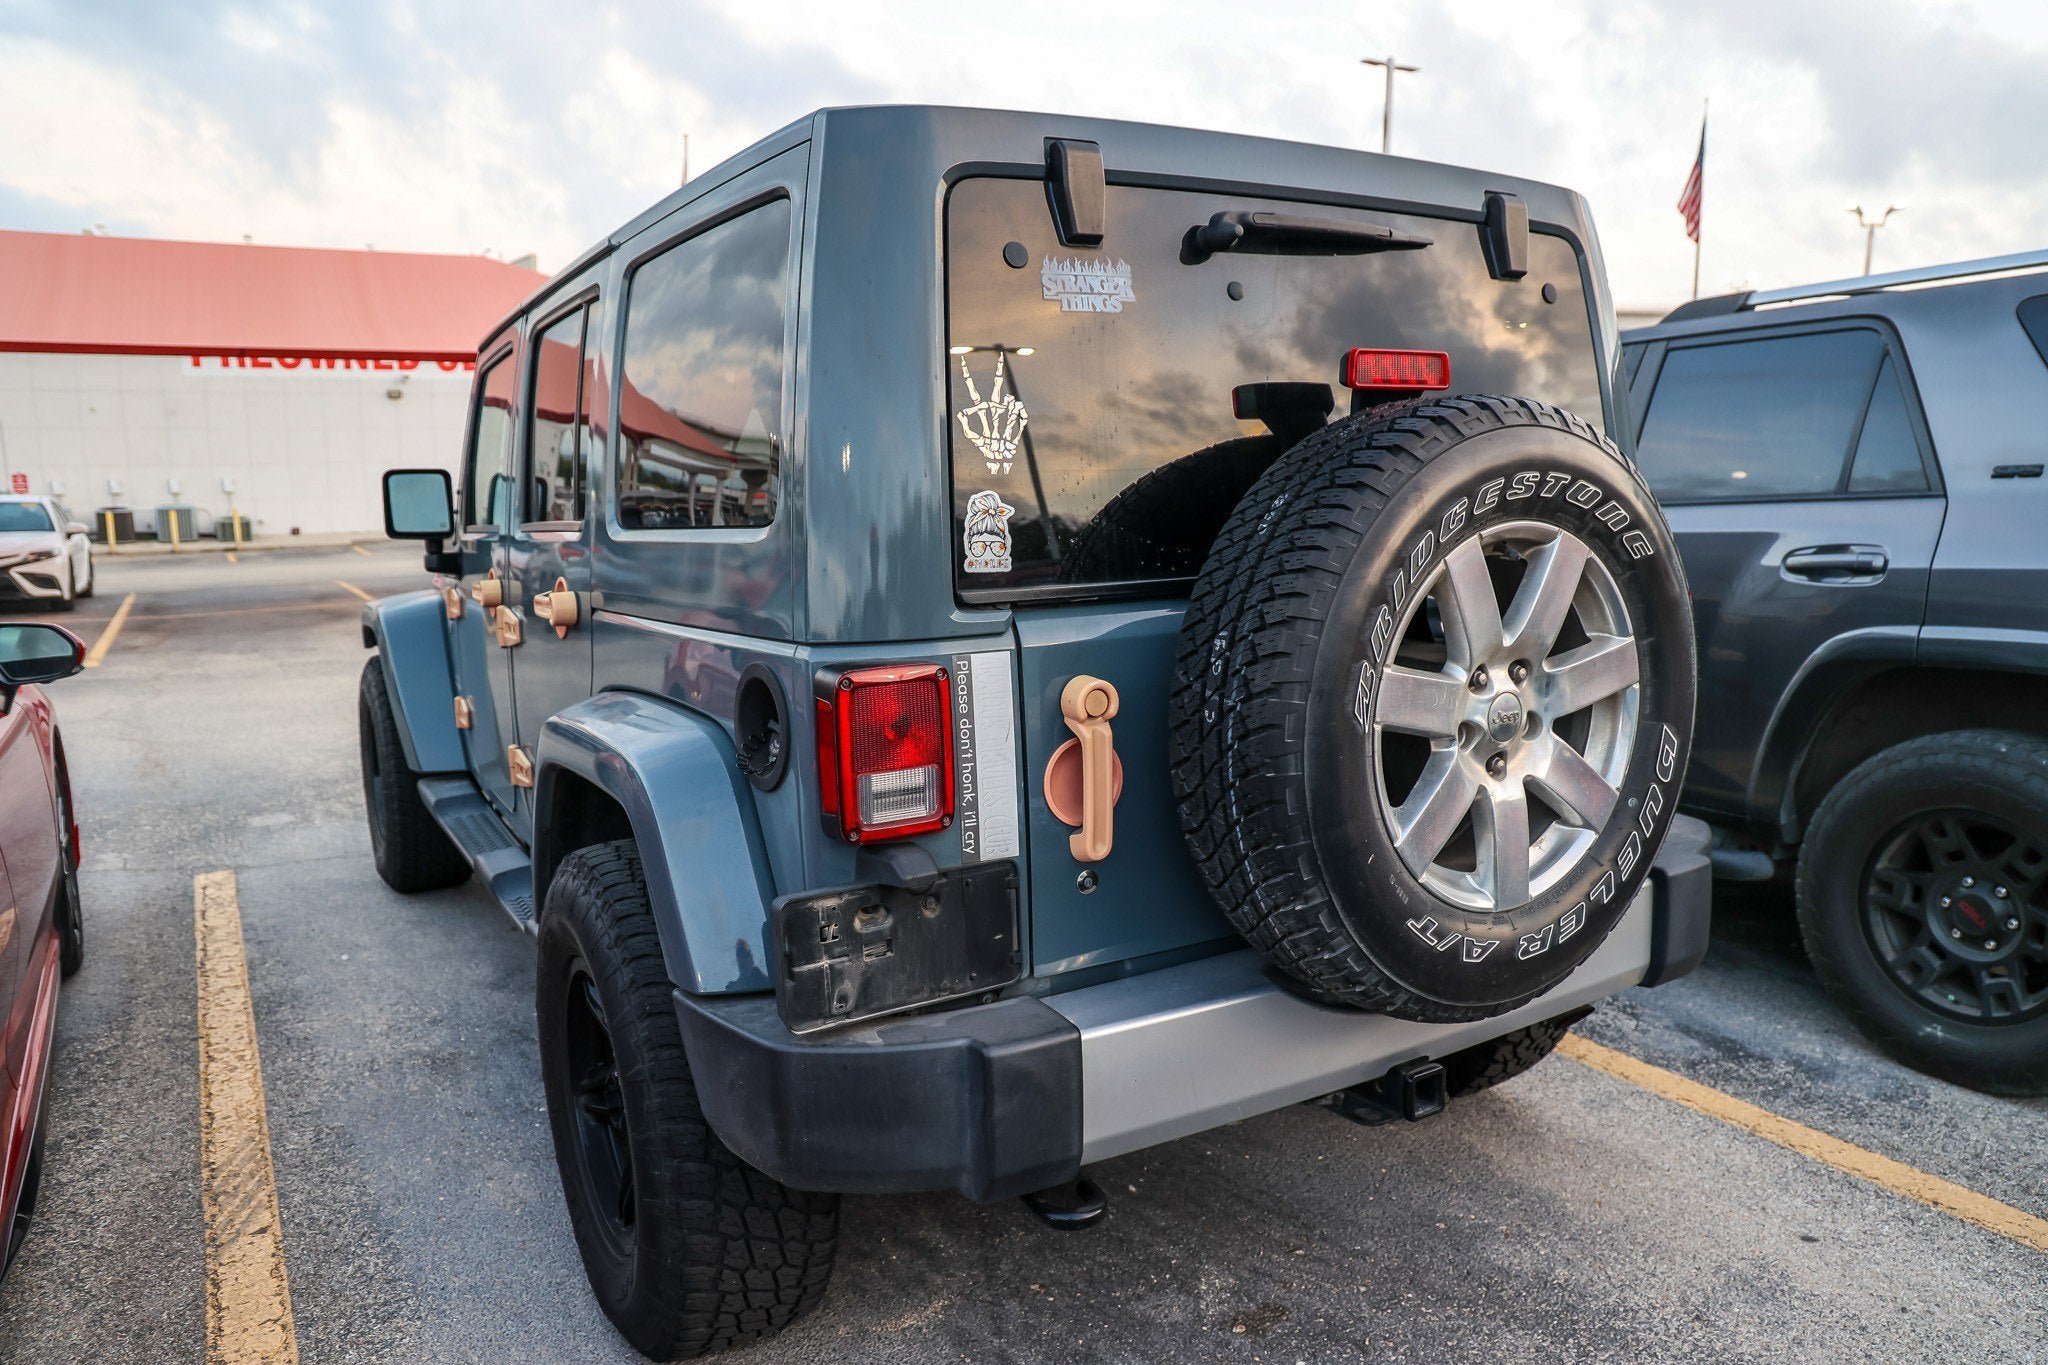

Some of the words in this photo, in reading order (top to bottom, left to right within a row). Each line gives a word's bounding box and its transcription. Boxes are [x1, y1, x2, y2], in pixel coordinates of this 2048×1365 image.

[1041, 273, 1135, 299] STRANGER
[1061, 294, 1123, 313] THINGS
[1354, 471, 1654, 734] BRIDGESTONE
[956, 660, 970, 714] Please
[1492, 710, 1519, 724] Jeep
[960, 718, 973, 758] don't
[962, 763, 976, 806] honk,
[964, 811, 977, 827] i'll
[963, 831, 975, 854] cry
[1517, 725, 1678, 961] DUELER
[1406, 915, 1500, 963] A/T
